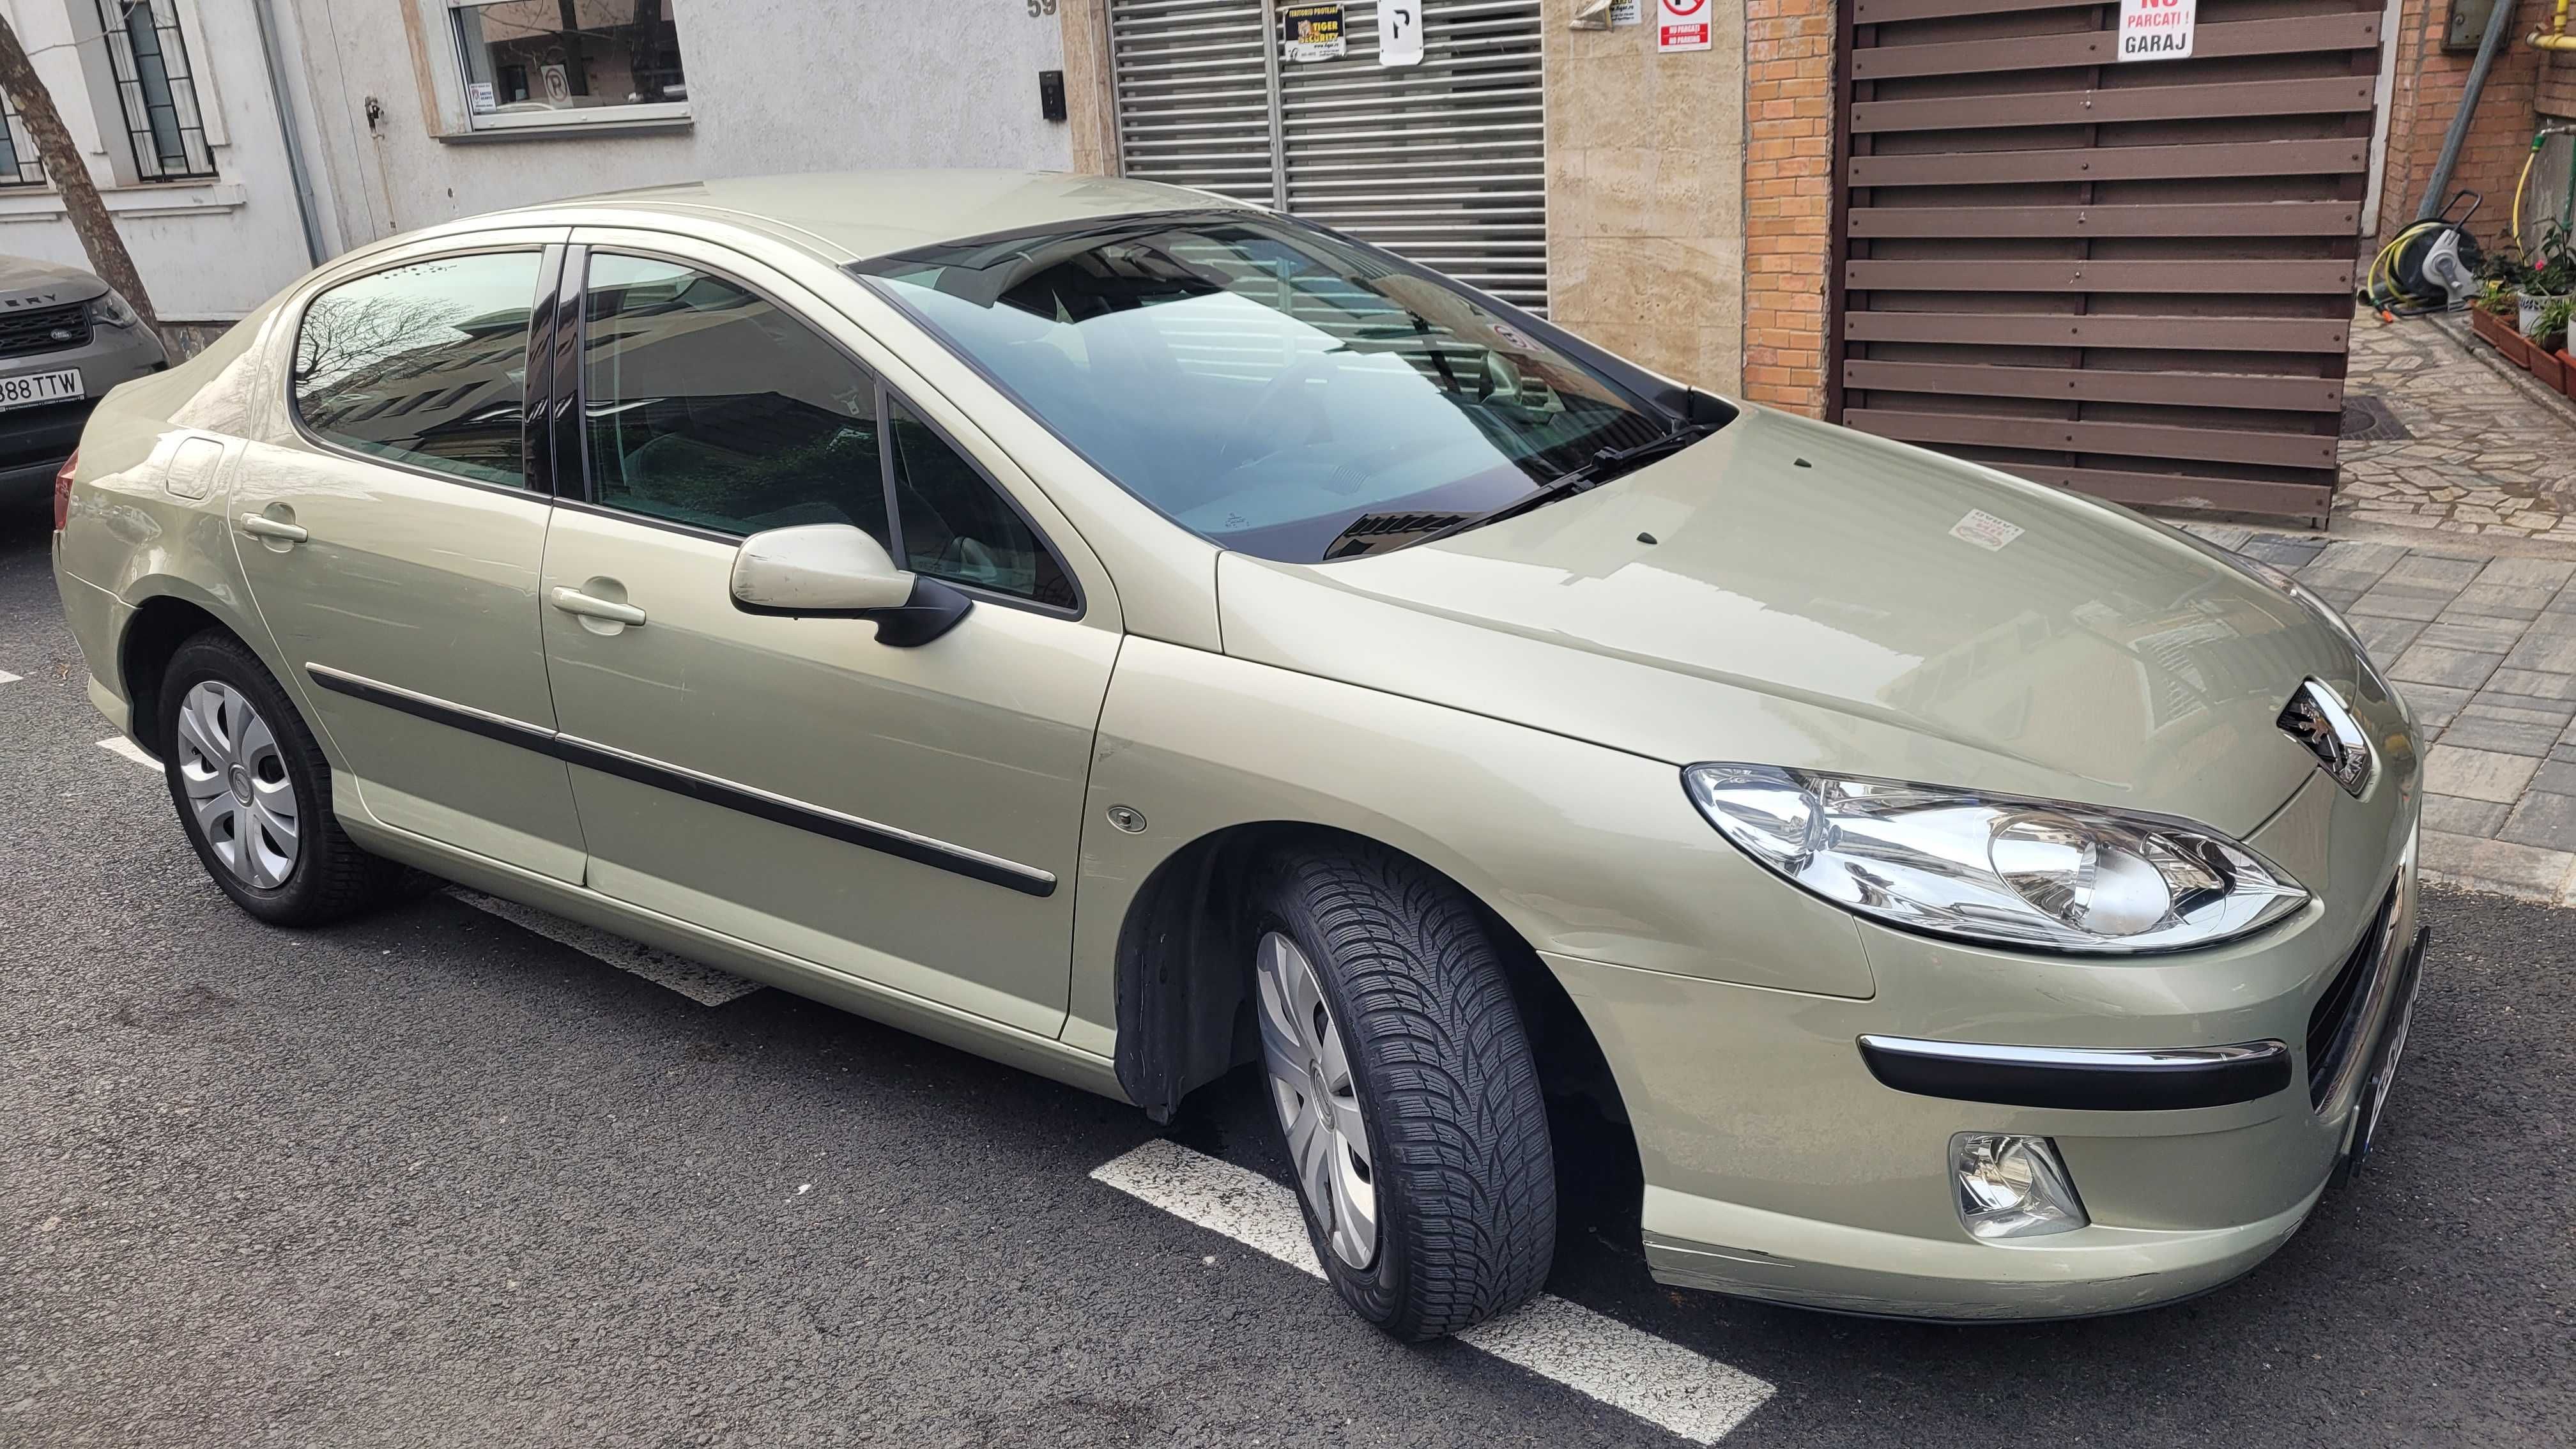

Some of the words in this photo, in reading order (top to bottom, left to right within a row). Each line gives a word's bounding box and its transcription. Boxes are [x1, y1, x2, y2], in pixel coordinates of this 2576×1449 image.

[1027, 0, 1057, 17] 59
[1313, 20, 1338, 31] TIGER
[1298, 33, 1339, 44] SECURITY
[2126, 33, 2186, 53] GARAJ
[33, 372, 75, 397] TTW
